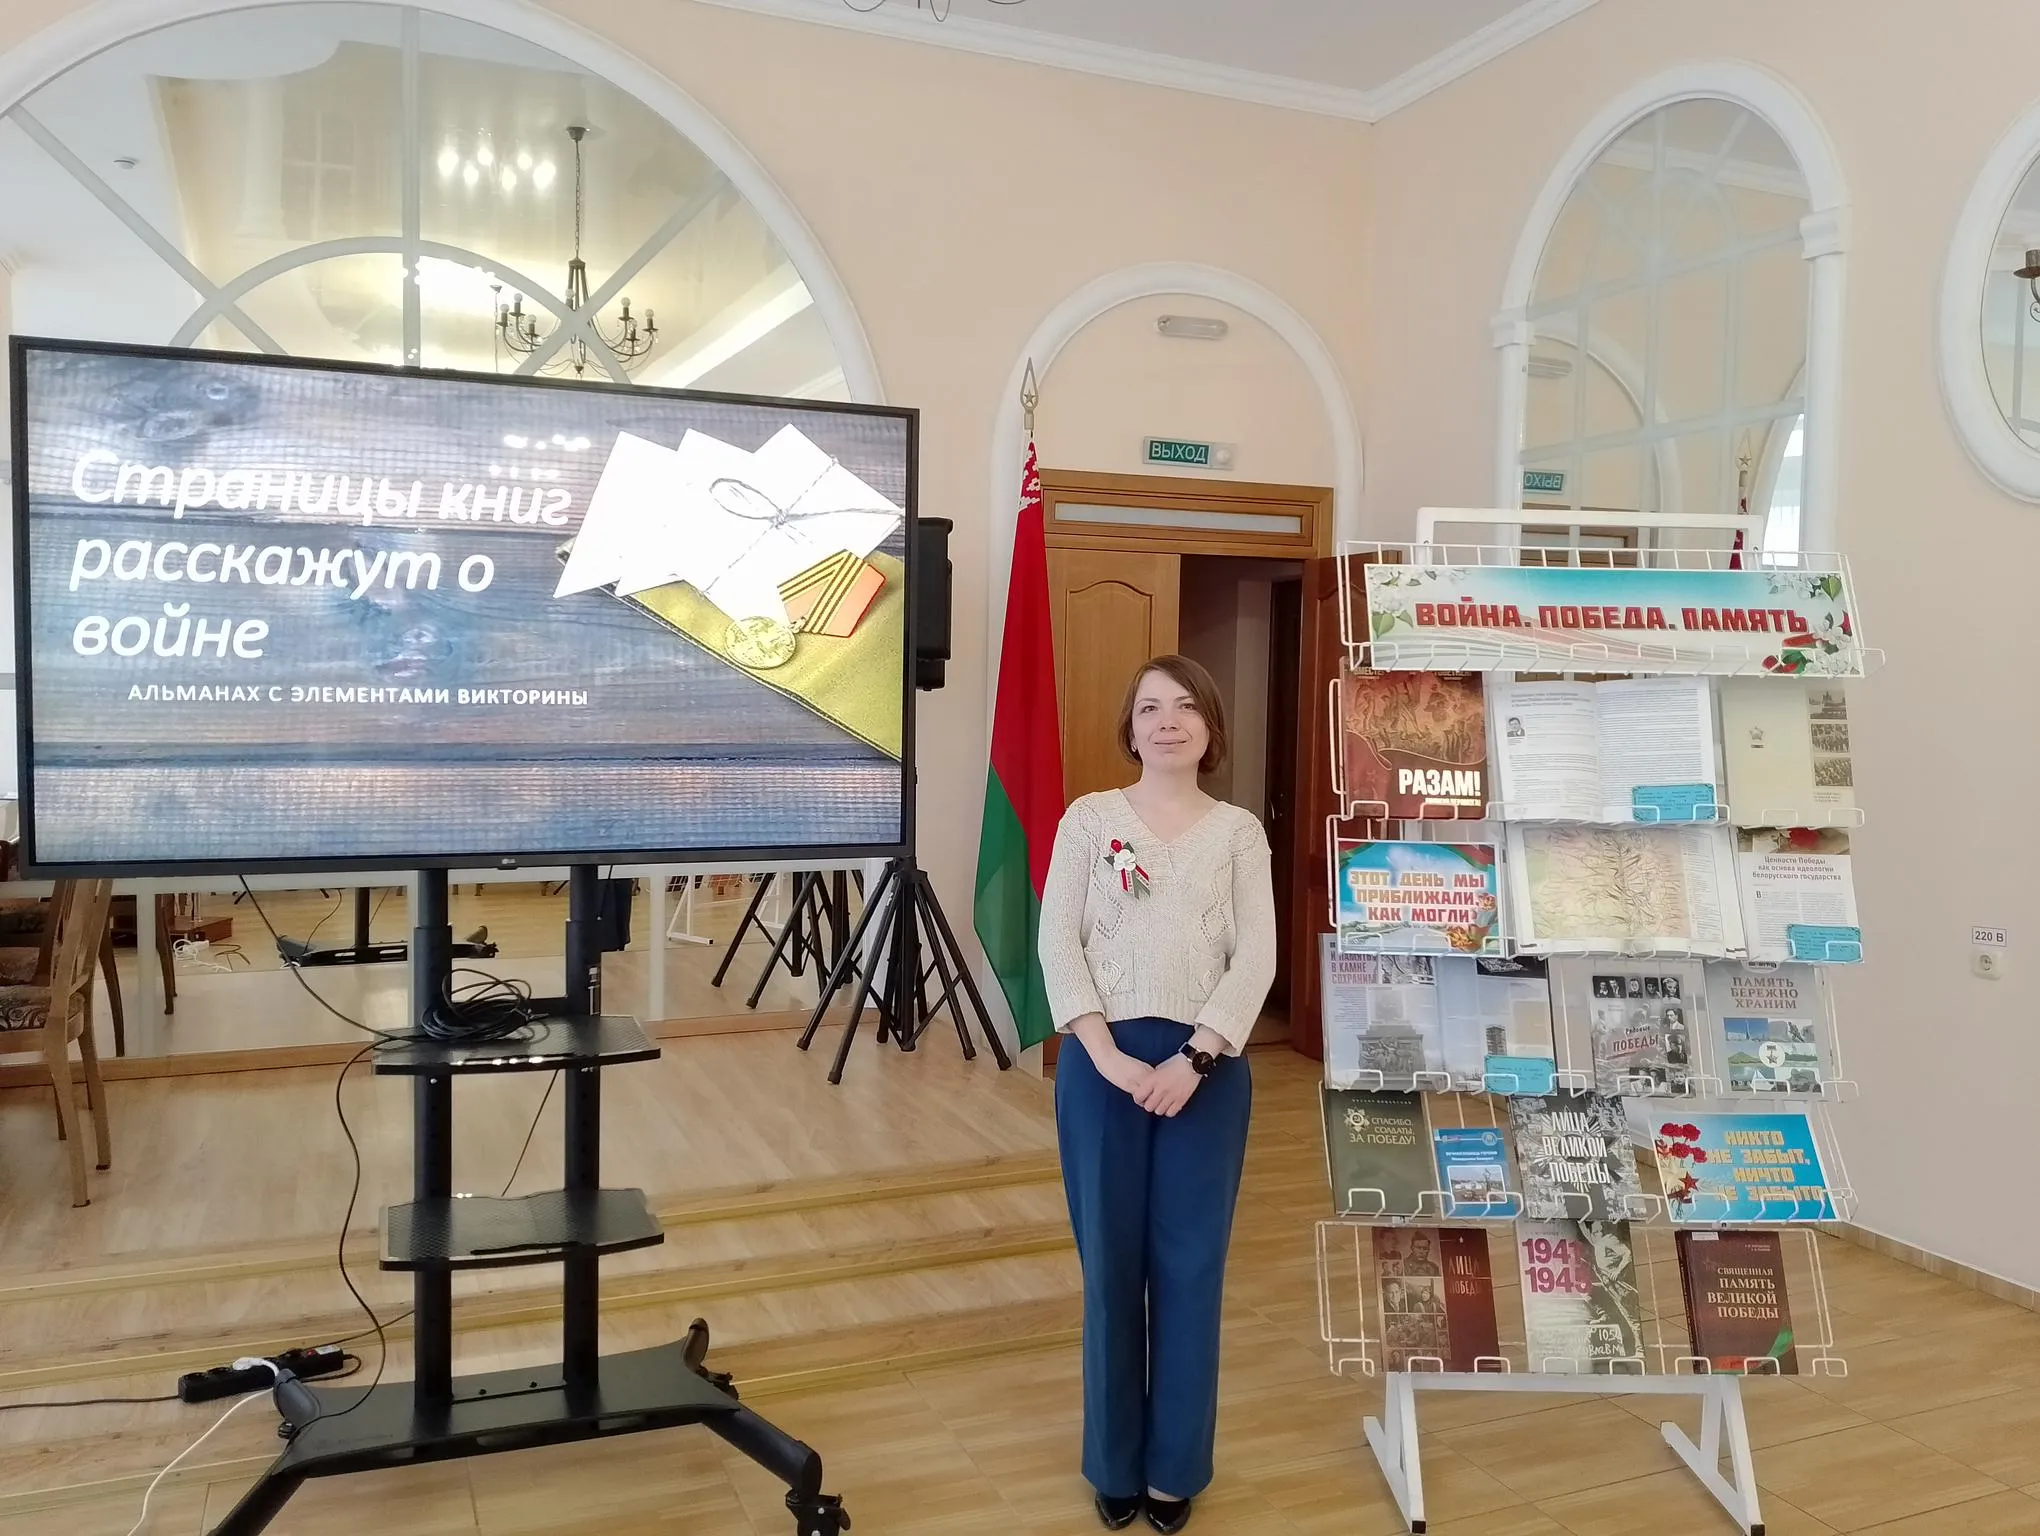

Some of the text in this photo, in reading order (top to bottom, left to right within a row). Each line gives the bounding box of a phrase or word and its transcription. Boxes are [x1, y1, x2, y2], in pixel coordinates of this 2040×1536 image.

[1152, 442, 1205, 462] ВЫХОД
[72, 449, 572, 526] Страницы книг
[69, 538, 495, 600] расскажут о
[1415, 596, 1809, 633] ВОЙНА. ПОБЕДА. ПАМЯТЬ
[72, 601, 269, 659] войне
[127, 684, 588, 705] АЛЬМАНАХ С ЭЛЕМЕНТАМИ ВИКТОРИНЫ
[1398, 768, 1481, 797] РАЗАМ!
[1764, 856, 1826, 865] Ценности Победы
[1350, 870, 1485, 888] ЭТОТ ДЕНЬ МЫ
[1367, 907, 1401, 921] КАК
[1975, 930, 2004, 942] 220 В
[1339, 962, 1367, 973] КАМНЕ
[1732, 976, 1794, 988] ПАМЯТЬ
[1731, 987, 1798, 998] БЕРЕЖНО
[1735, 998, 1797, 1009] ХРАНИМ
[1613, 1035, 1658, 1052] ПОБЕДЫ
[1551, 1111, 1590, 1134] ЛИЦА
[1349, 1133, 1416, 1145] ЗА ПОБЕДУ!
[1725, 1130, 1784, 1146] НИКТО
[1707, 1149, 1733, 1164] НЕ
[1549, 1161, 1611, 1184] ПОБЕДЫ
[1734, 1167, 1795, 1182] НИЧТО
[1522, 1237, 1582, 1265] 1941
[1717, 1267, 1774, 1276] СВЯЩЕННАЯ
[1719, 1278, 1776, 1289] ПАМЯТЬ
[1707, 1291, 1778, 1305] ВЕЛИКОЙ
[1717, 1306, 1780, 1320] ПОБЕДЫ
